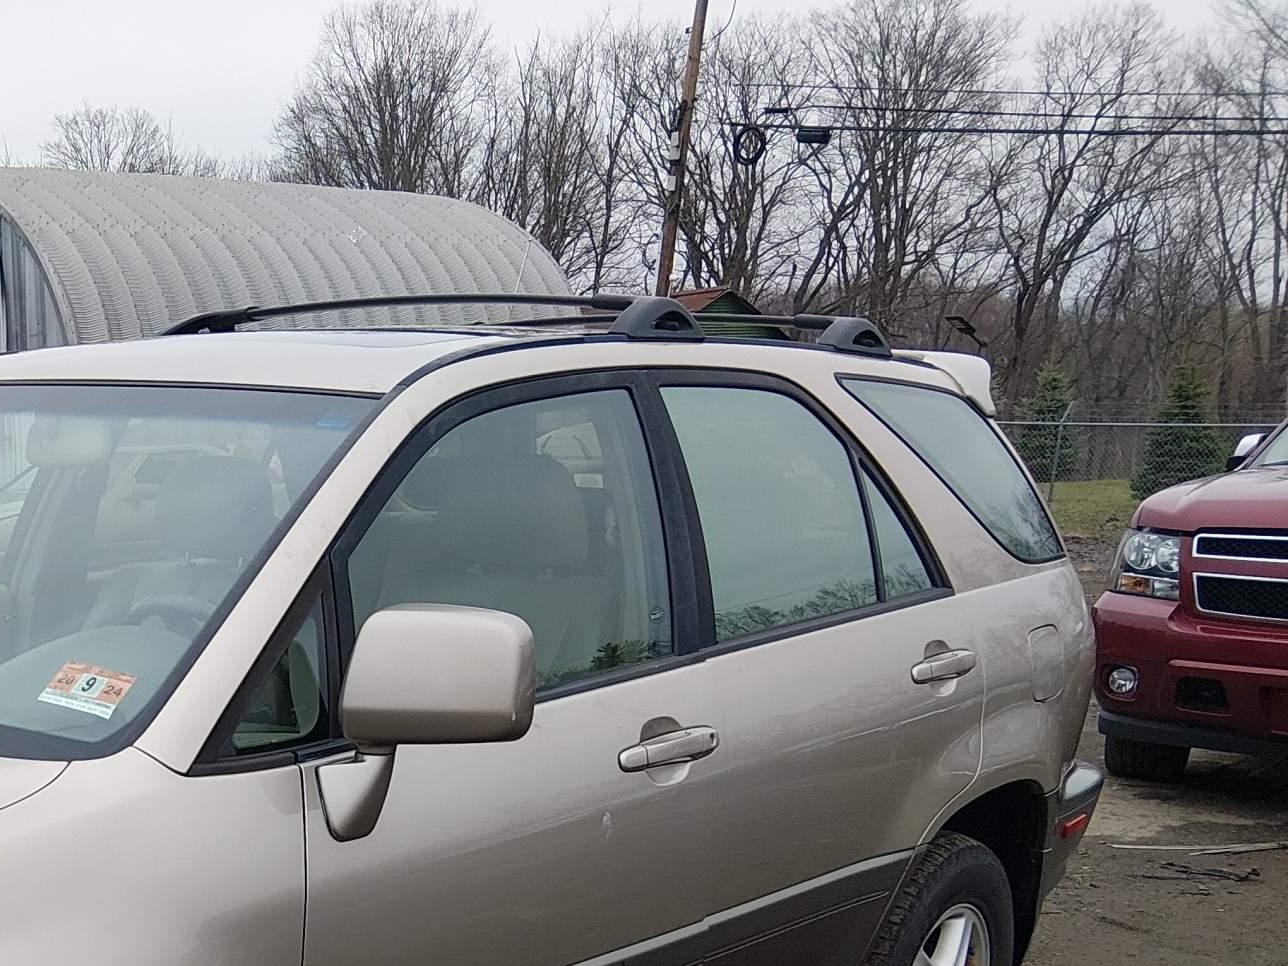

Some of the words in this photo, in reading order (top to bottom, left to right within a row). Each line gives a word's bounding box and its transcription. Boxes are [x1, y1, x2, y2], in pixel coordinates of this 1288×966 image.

[57, 673, 76, 685] 20
[81, 676, 97, 692] 9
[103, 684, 122, 698] 24
